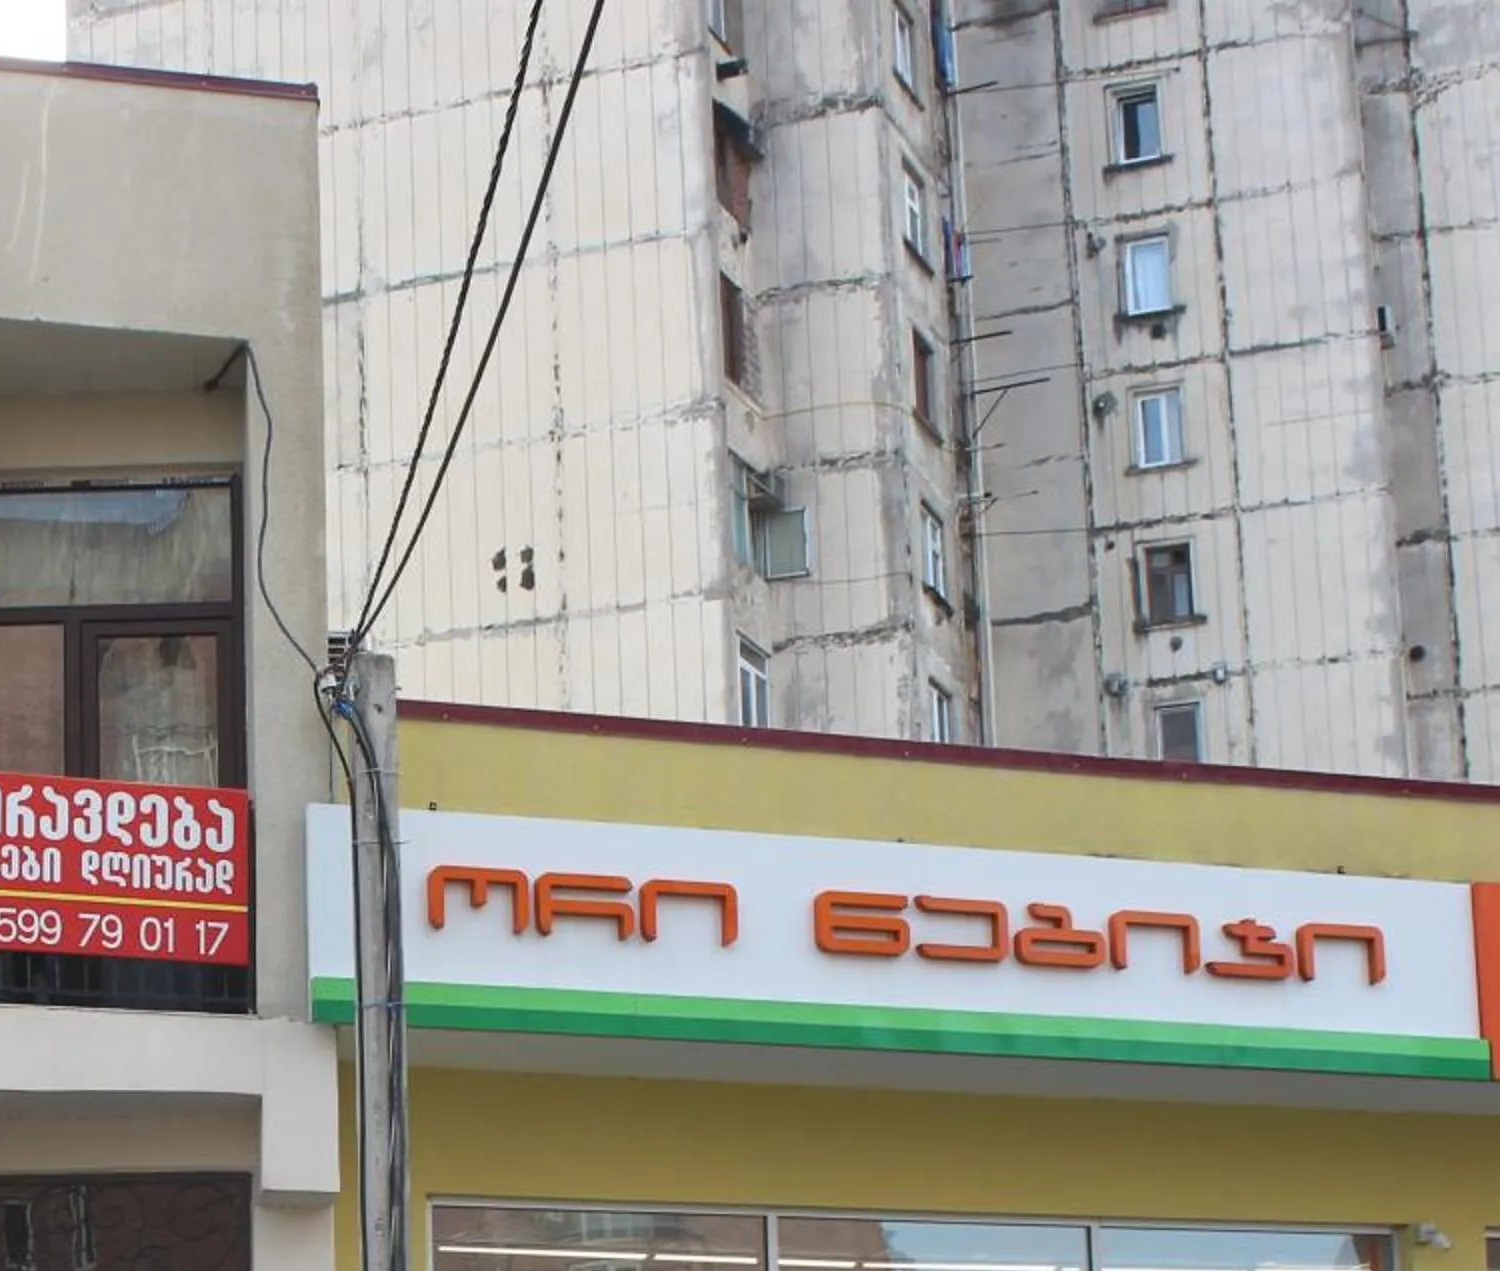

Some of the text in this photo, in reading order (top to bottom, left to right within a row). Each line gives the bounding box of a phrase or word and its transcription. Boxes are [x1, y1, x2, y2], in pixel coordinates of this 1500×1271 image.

[81, 850, 235, 895] დღიურად
[78, 912, 123, 949] 79
[139, 917, 176, 953] 01
[196, 920, 229, 956] 17
[427, 865, 1386, 986] ორი ნაბიჯი
